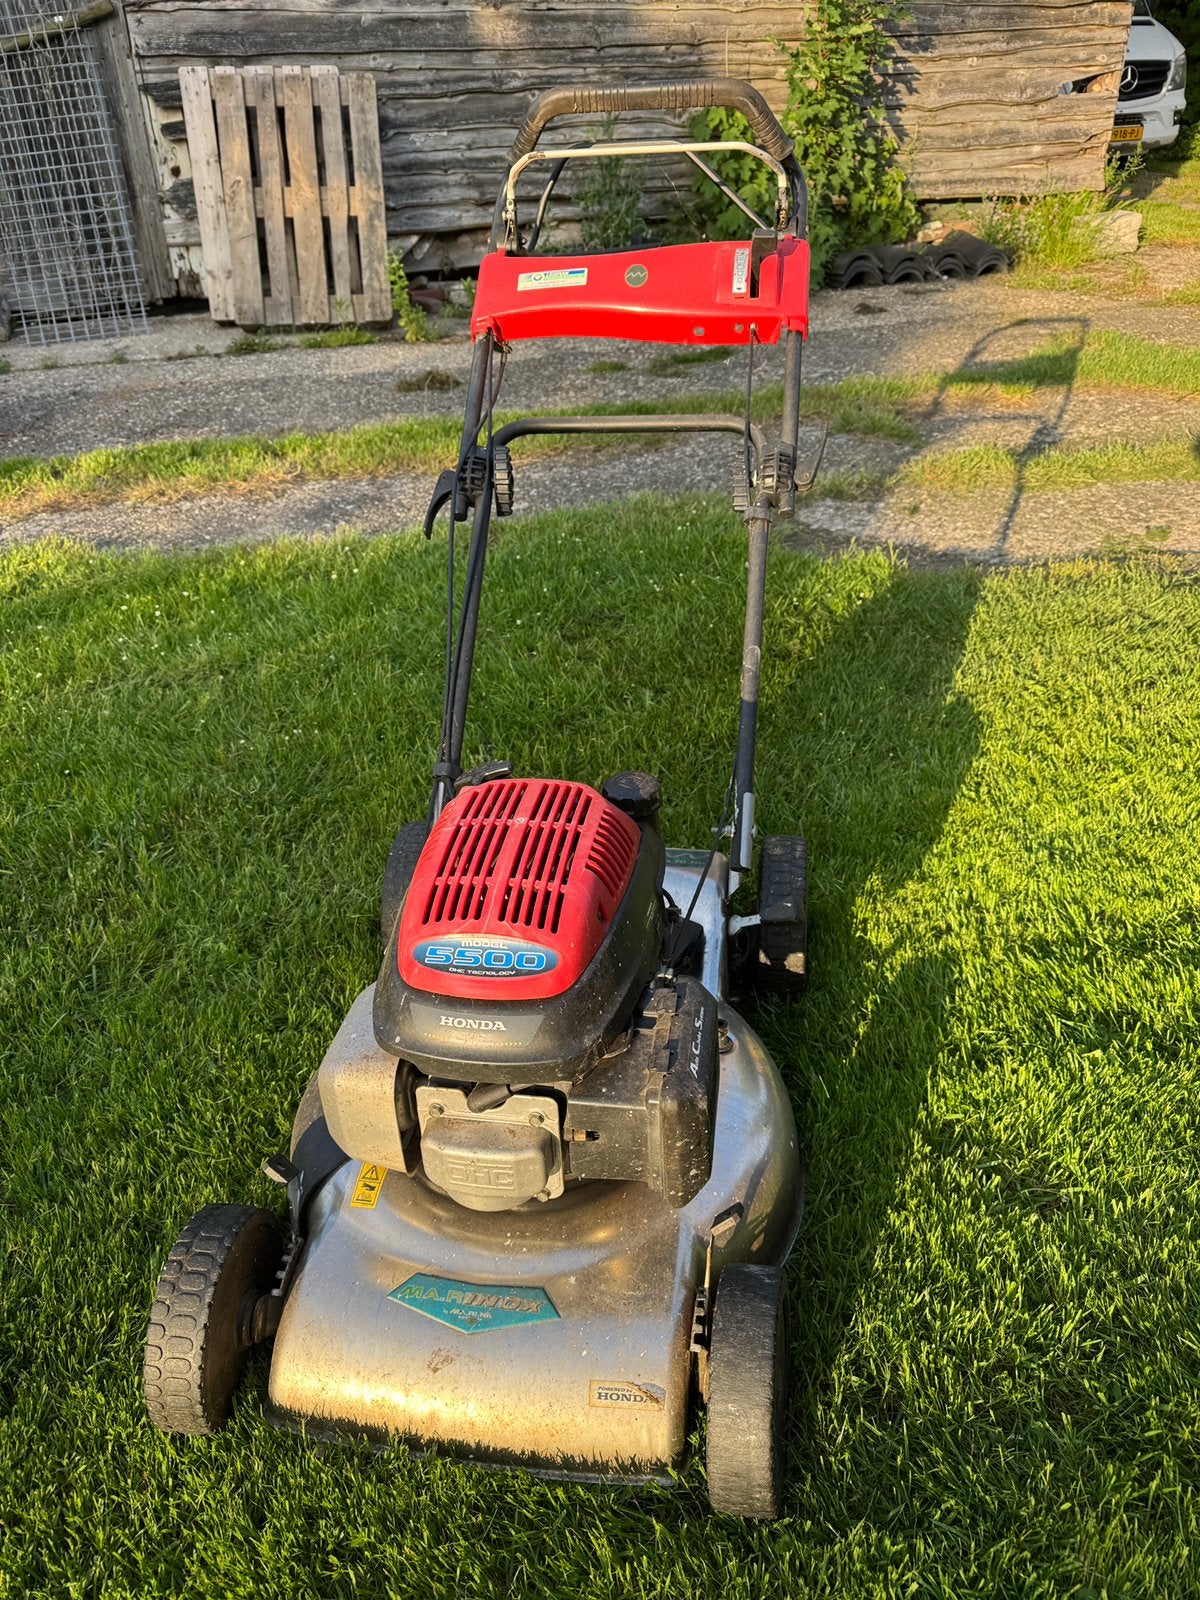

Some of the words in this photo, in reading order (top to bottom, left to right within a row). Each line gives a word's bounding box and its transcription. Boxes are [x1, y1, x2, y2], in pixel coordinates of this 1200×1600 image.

[461, 940, 509, 949] MODEL
[424, 946, 546, 971] 5500
[440, 1015, 507, 1031] HONDA
[447, 1164, 514, 1186] OHC
